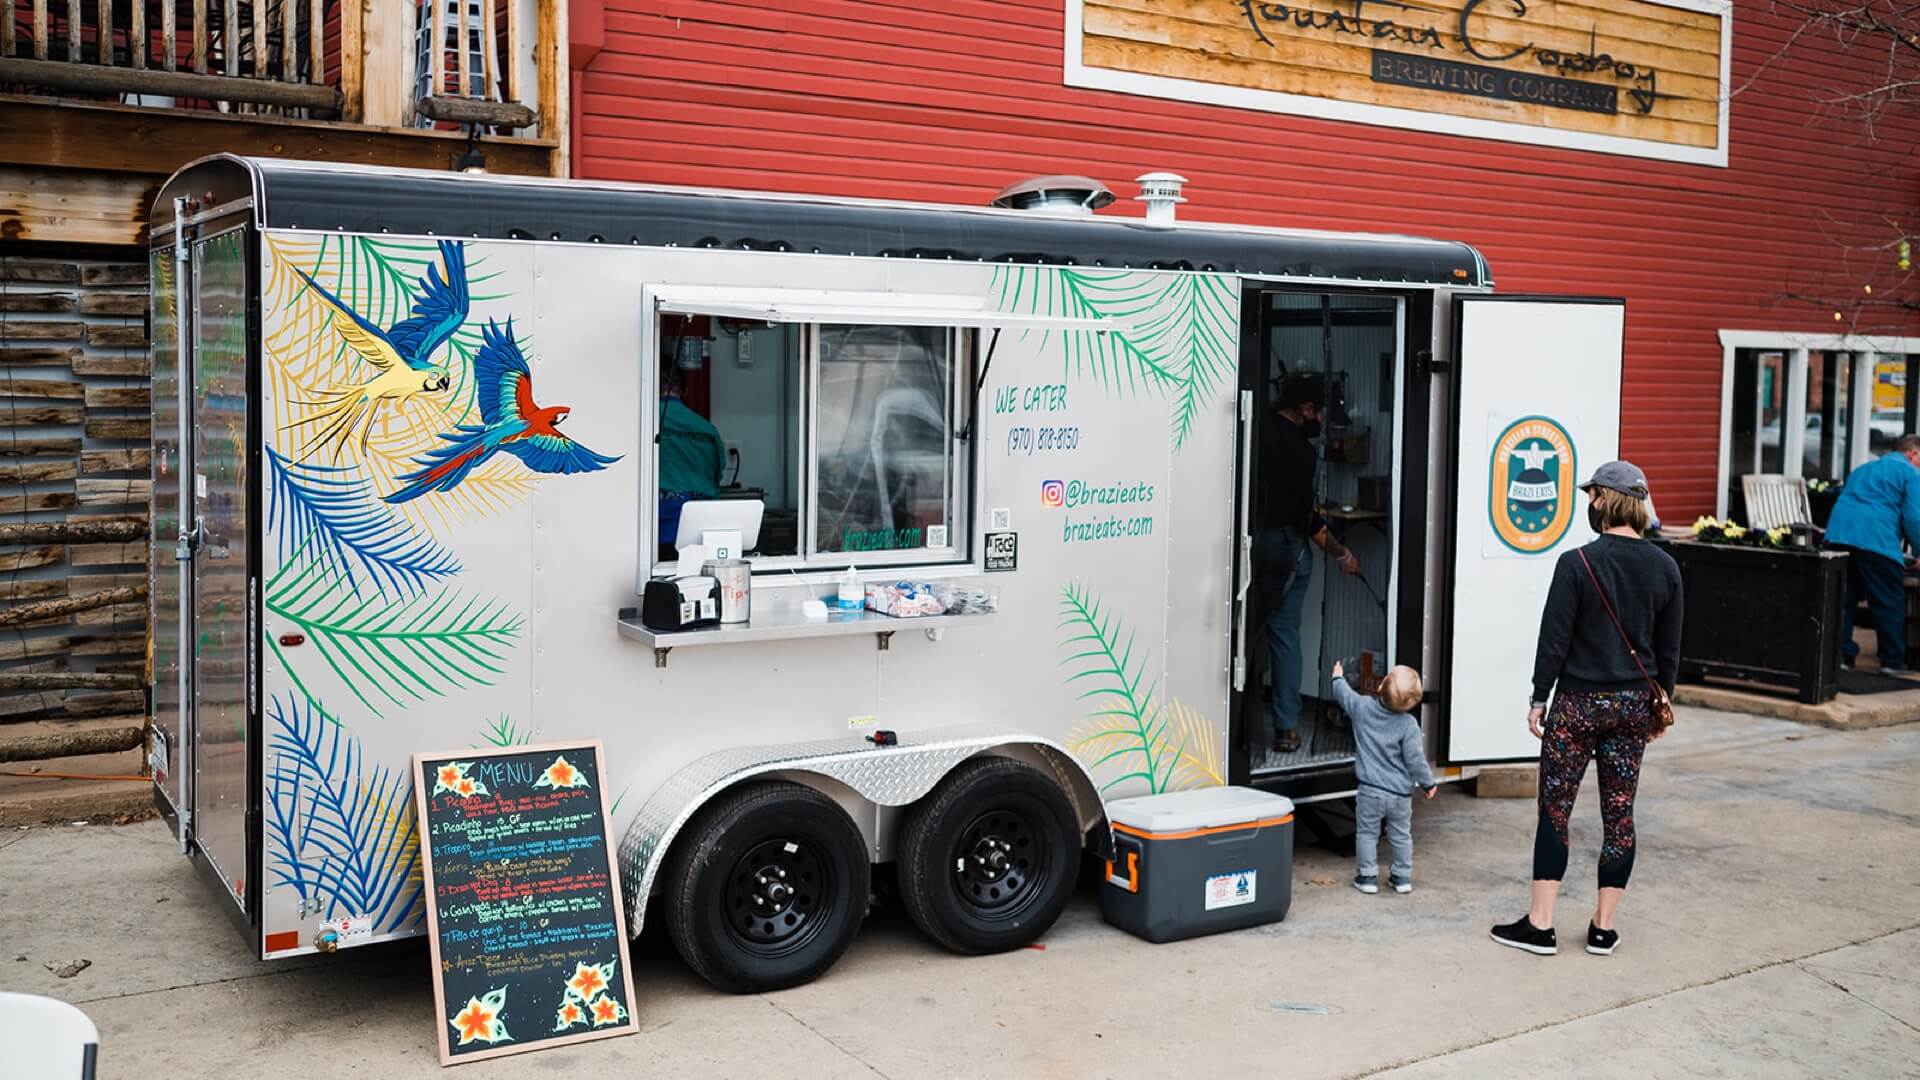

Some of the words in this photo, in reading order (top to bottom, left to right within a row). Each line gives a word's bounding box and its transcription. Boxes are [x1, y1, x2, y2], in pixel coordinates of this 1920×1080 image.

[1241, 0, 1445, 49] ountain
[1379, 57, 1496, 95] BREWING
[1507, 76, 1614, 110] COMPANY
[995, 386, 1018, 414] WE
[1023, 384, 1068, 412] CATER
[1008, 427, 1035, 456] (970)
[1038, 427, 1079, 451] 818-8150
[1064, 480, 1154, 508] @brazieats
[1536, 486, 1555, 497] EATS
[1063, 516, 1153, 542] brazieats.com
[479, 762, 534, 788] MENU
[509, 814, 521, 824] GF
